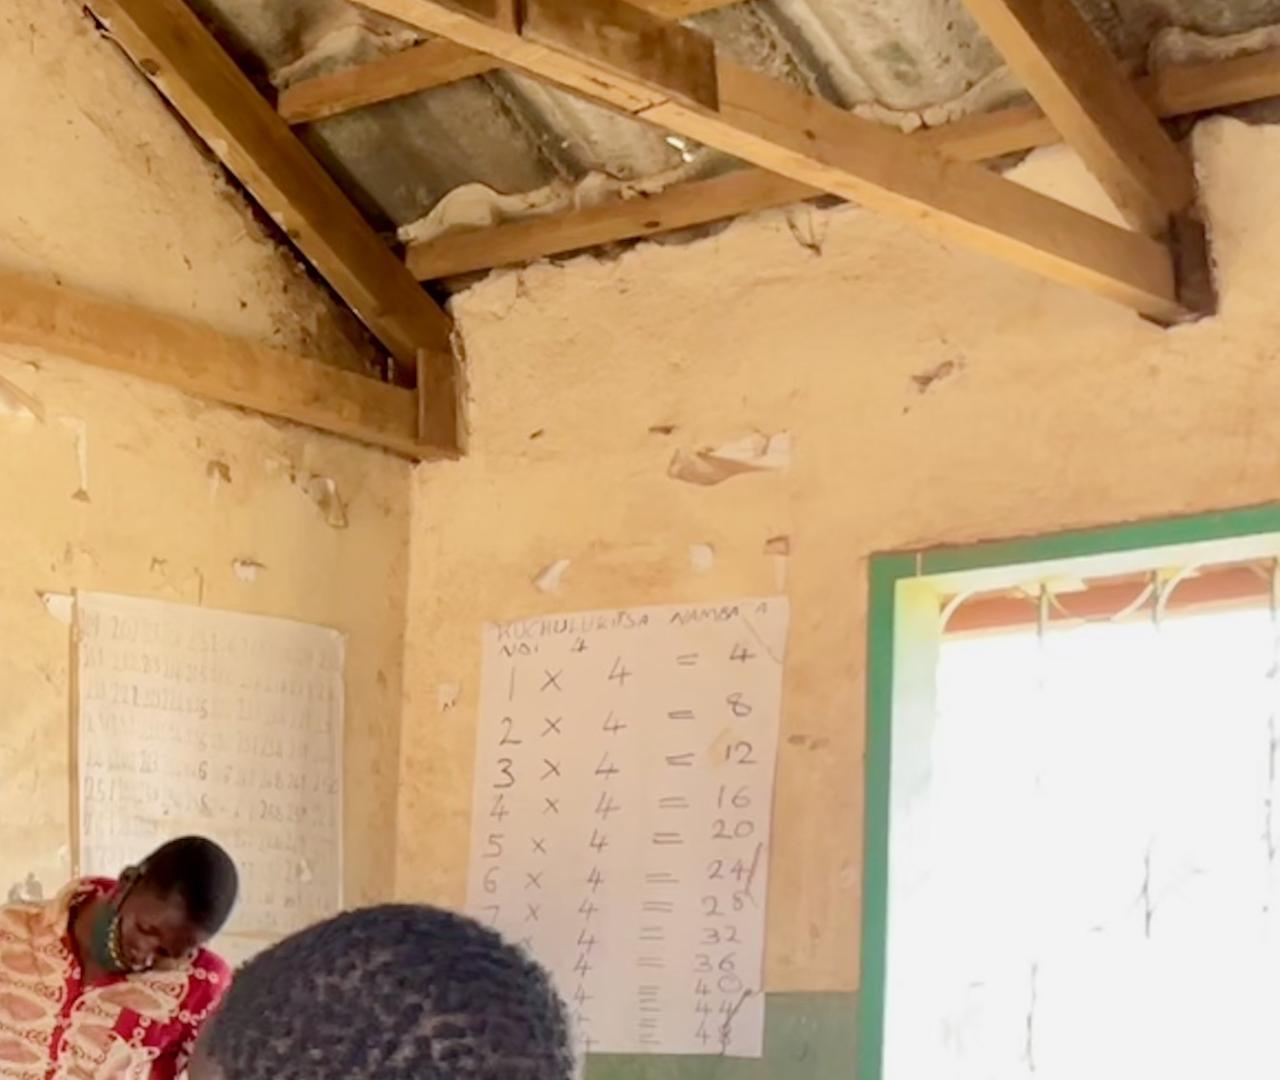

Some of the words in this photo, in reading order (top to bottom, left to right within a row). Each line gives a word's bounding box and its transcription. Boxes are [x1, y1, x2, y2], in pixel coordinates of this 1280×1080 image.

[507, 665, 516, 702] 1
[608, 655, 632, 687] 4
[728, 642, 756, 663] 4
[498, 716, 522, 746] 2
[602, 710, 627, 735] 4
[725, 692, 752, 718] 8
[493, 757, 515, 788] 3
[595, 751, 620, 780] 4
[725, 740, 757, 765] 12
[489, 793, 510, 823] 4
[594, 791, 622, 820] 4
[717, 784, 751, 809] 16
[482, 833, 504, 858] 5
[590, 828, 609, 853] 4
[712, 818, 755, 840] 20
[483, 866, 501, 895] 6
[587, 866, 604, 893] 4
[707, 858, 750, 881] 24
[578, 898, 598, 920] 4
[702, 893, 747, 916] 28
[577, 928, 600, 953] 4
[702, 926, 742, 946] 32
[573, 953, 593, 976] 4
[693, 953, 736, 973] 36
